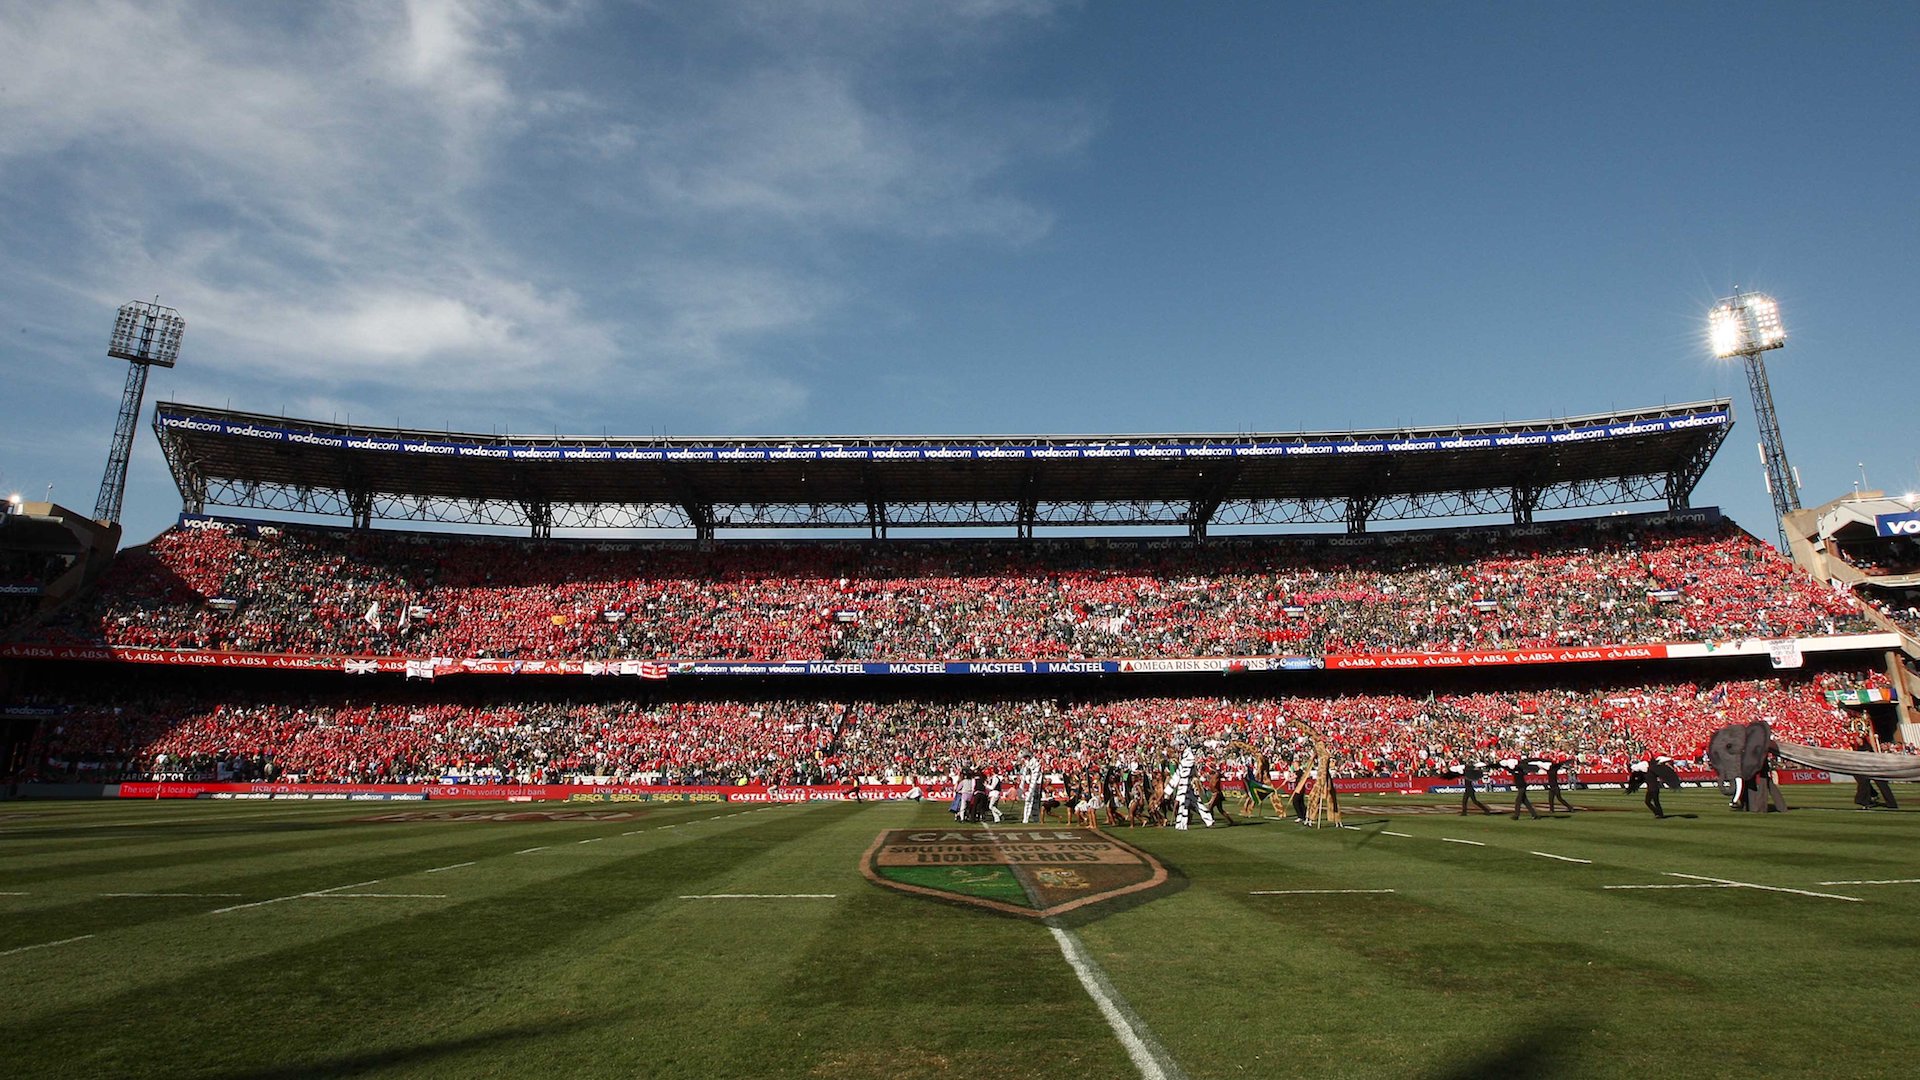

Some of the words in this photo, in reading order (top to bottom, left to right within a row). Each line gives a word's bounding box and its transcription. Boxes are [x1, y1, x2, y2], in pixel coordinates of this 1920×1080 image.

[162, 418, 220, 432] vodacom
[226, 424, 282, 440] vodacom
[288, 433, 342, 447] vodacom
[347, 438, 399, 450] vodacom
[404, 442, 454, 454] vodacom
[459, 446, 508, 458] vodacom
[512, 448, 560, 458] vodacom
[564, 448, 611, 458] vodacom
[615, 448, 662, 458] vodacom
[666, 448, 713, 458] vodacom
[718, 448, 764, 458] vodacom
[769, 448, 816, 458] vodacom
[820, 448, 868, 458] vodacom
[872, 448, 919, 458] vodacom
[924, 447, 971, 458] vodacom
[977, 447, 1025, 458] vodacom
[1031, 447, 1078, 458] vodacom
[1083, 447, 1130, 456] vodacom
[1134, 446, 1181, 456] vodacom
[1185, 445, 1232, 456] vodacom
[1236, 445, 1282, 455] vodacom
[1286, 444, 1333, 454] vodacom
[1337, 443, 1383, 452] vodacom
[1388, 440, 1436, 451] vodacom
[1440, 438, 1490, 449] vodacom
[1496, 434, 1546, 446] vodacom
[1551, 428, 1604, 442] vodacom
[1608, 422, 1664, 436] vodacom
[1669, 414, 1726, 428] vodacom
[133, 653, 164, 661] ABSA
[186, 655, 216, 663] ABSA
[239, 657, 267, 666] ABSA
[1352, 658, 1376, 666] ABSA
[1394, 658, 1419, 666] ABSA
[1437, 656, 1463, 664] ABSA
[730, 664, 766, 673] vodacom
[768, 664, 805, 673] vodacom
[810, 664, 866, 674] MACSTEEL
[889, 664, 946, 673] MACSTEEL
[969, 664, 1026, 673] MACSTEEL
[1048, 663, 1105, 672] MACSTEEL
[1134, 662, 1174, 670] OMEGA
[1176, 661, 1201, 670] RISK
[1792, 772, 1816, 780] HSBC
[1344, 781, 1373, 789] world's
[1374, 780, 1393, 788] local
[168, 786, 187, 794] local
[422, 786, 446, 796] HSBC
[462, 787, 475, 795] The
[478, 787, 506, 796] world's
[528, 787, 546, 796] bank
[907, 832, 1081, 842] CASTLE
[917, 853, 996, 862] LIONS
[1006, 852, 1100, 862] SERIES
